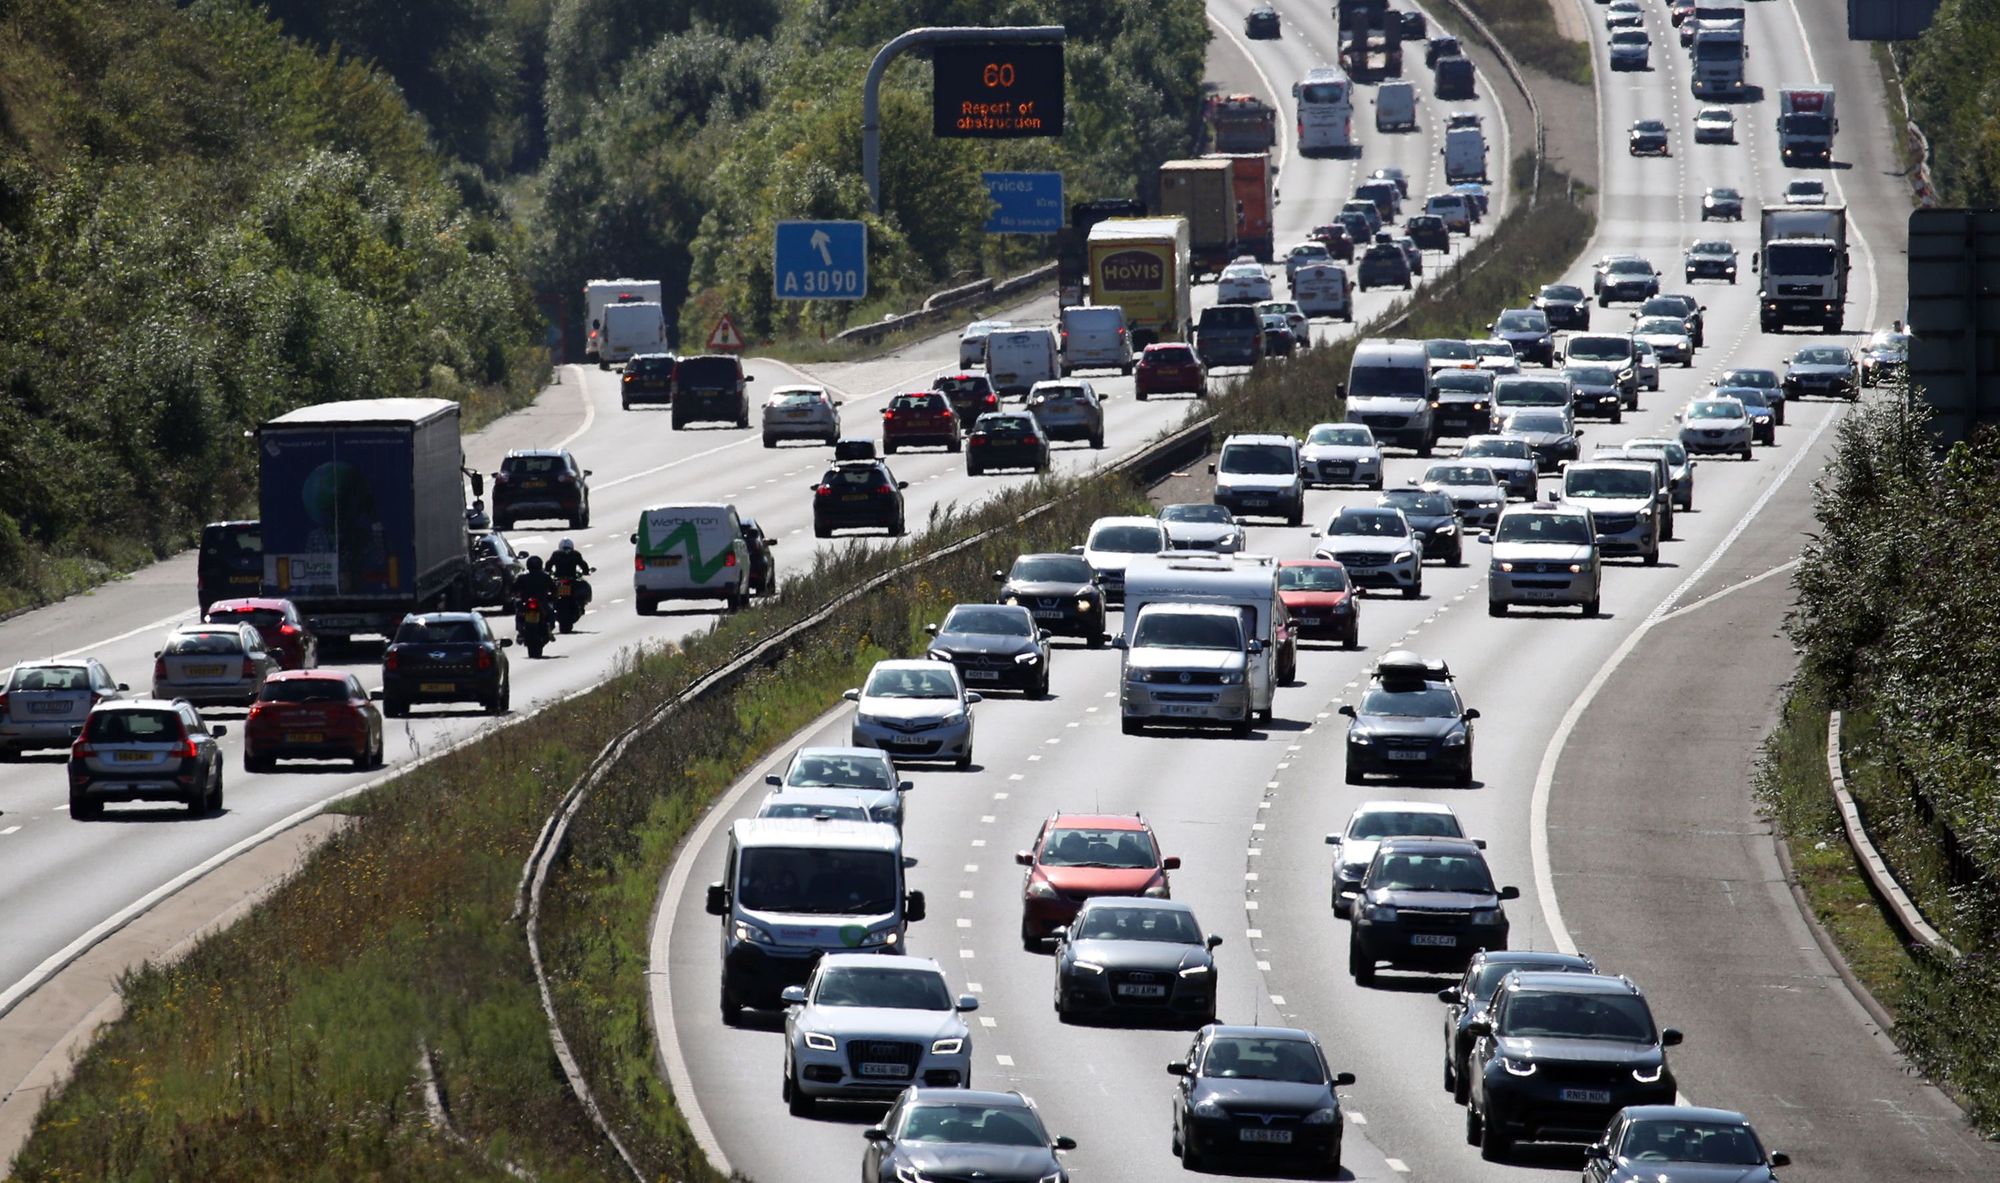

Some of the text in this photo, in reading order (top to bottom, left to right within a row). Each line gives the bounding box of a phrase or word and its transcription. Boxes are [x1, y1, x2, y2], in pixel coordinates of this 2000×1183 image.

[983, 63, 1015, 88] 60
[961, 101, 1034, 116] Report of
